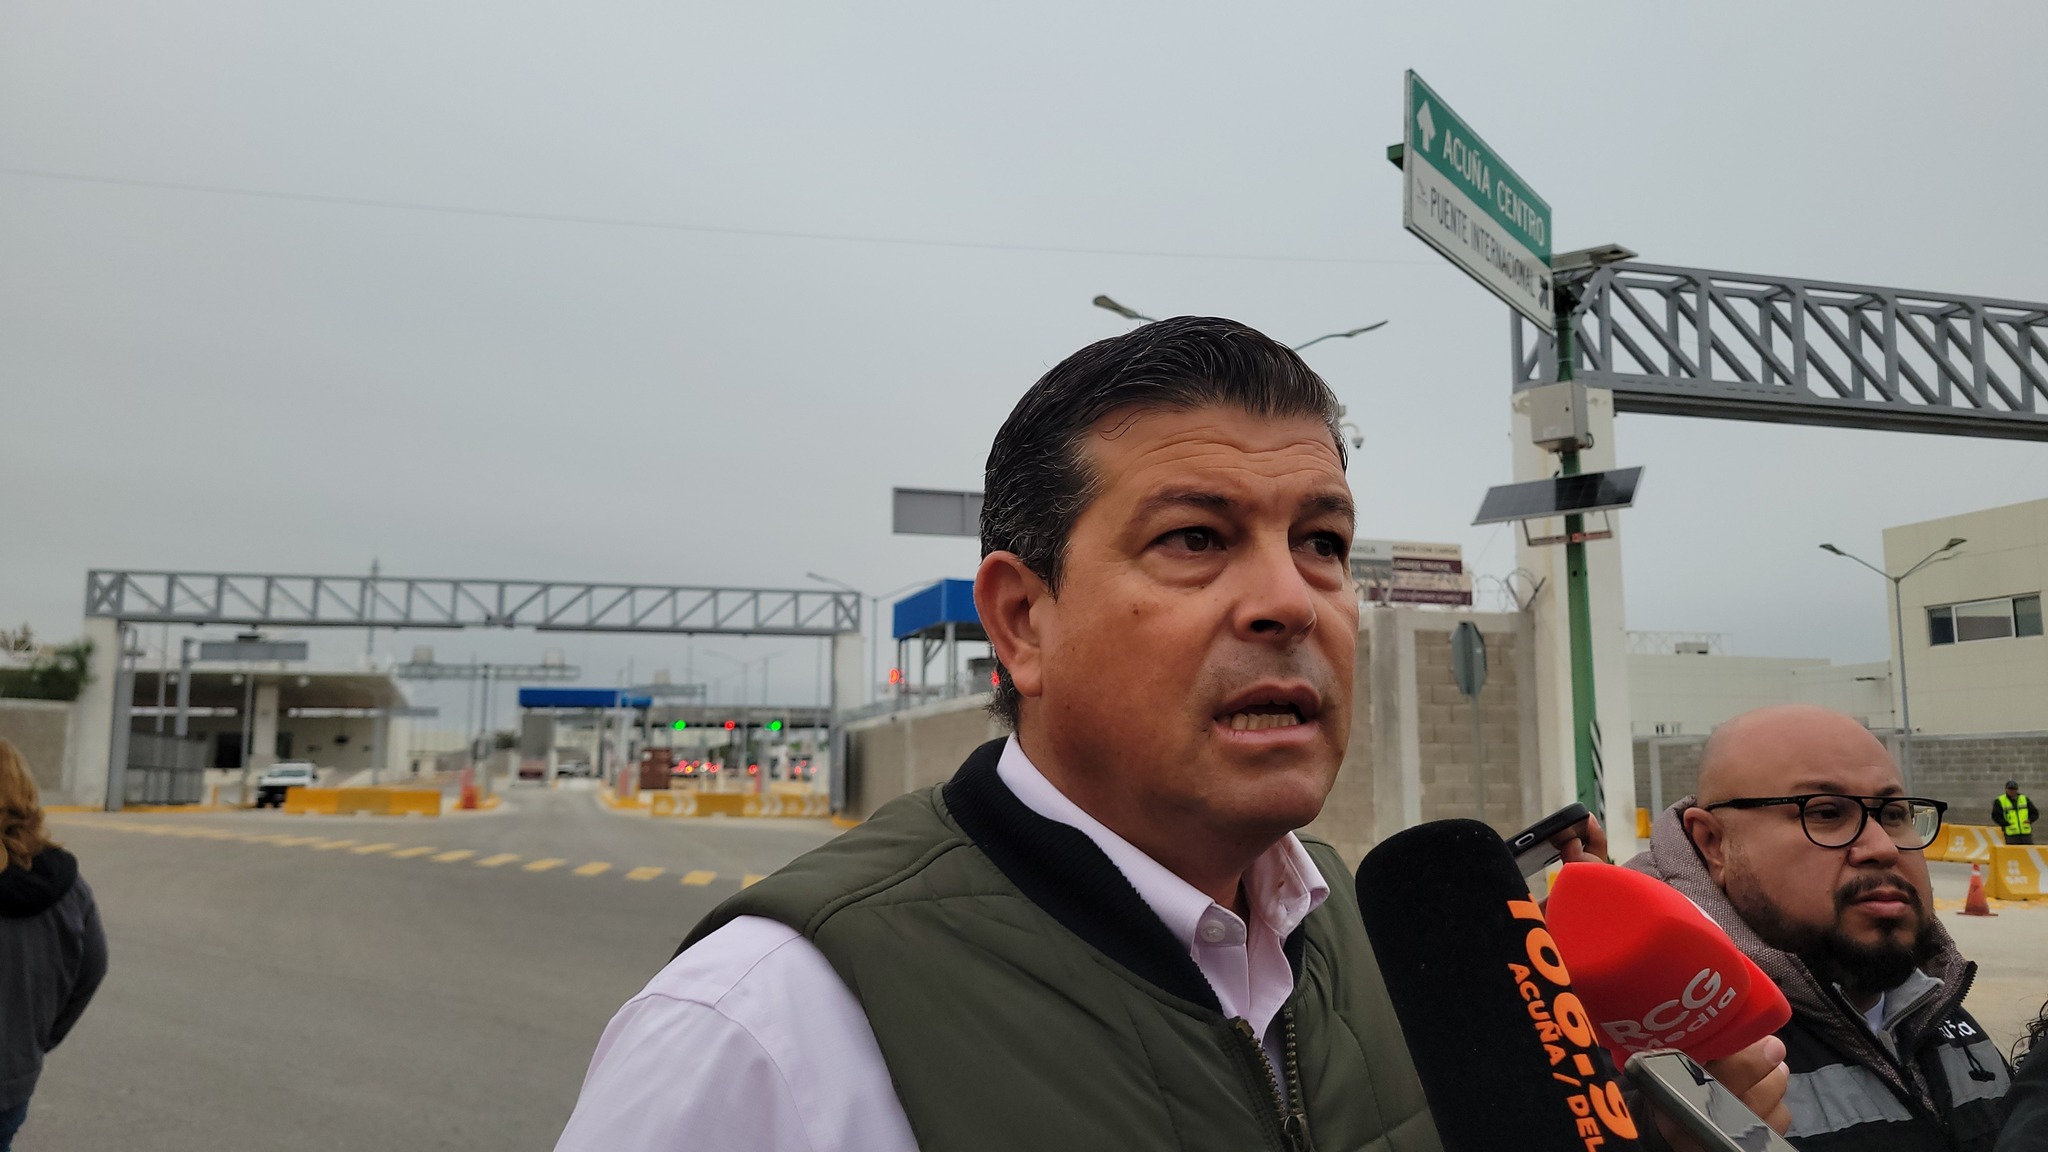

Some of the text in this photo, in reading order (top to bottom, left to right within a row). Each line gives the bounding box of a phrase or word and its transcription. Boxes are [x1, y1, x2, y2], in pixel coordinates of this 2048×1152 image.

[1430, 187, 1536, 298] PUENTE INTERNACIONAL
[1443, 129, 1545, 247] ACUÑA CENTRO
[1507, 963, 1567, 1067] ACUÑA
[1566, 1094, 1605, 1152] DEL
[1600, 967, 1722, 1044] RCG
